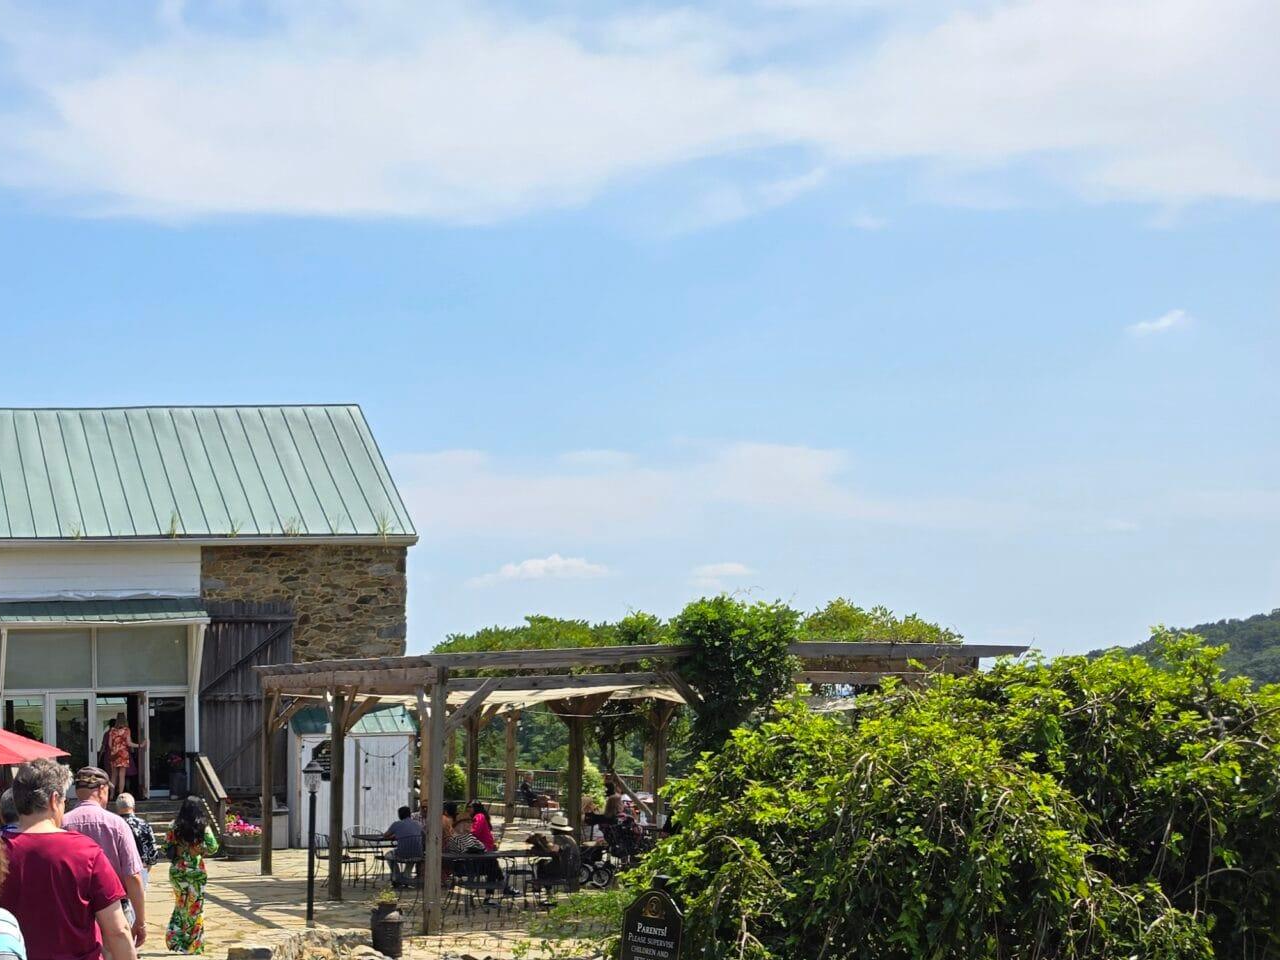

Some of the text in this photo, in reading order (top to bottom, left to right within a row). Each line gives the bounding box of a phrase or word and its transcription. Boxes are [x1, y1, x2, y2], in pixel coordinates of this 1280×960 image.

[637, 922, 667, 937] PARENTS!
[628, 932, 674, 949] PLEASE SUPERVISE
[631, 945, 669, 958] CHILDREN AND
